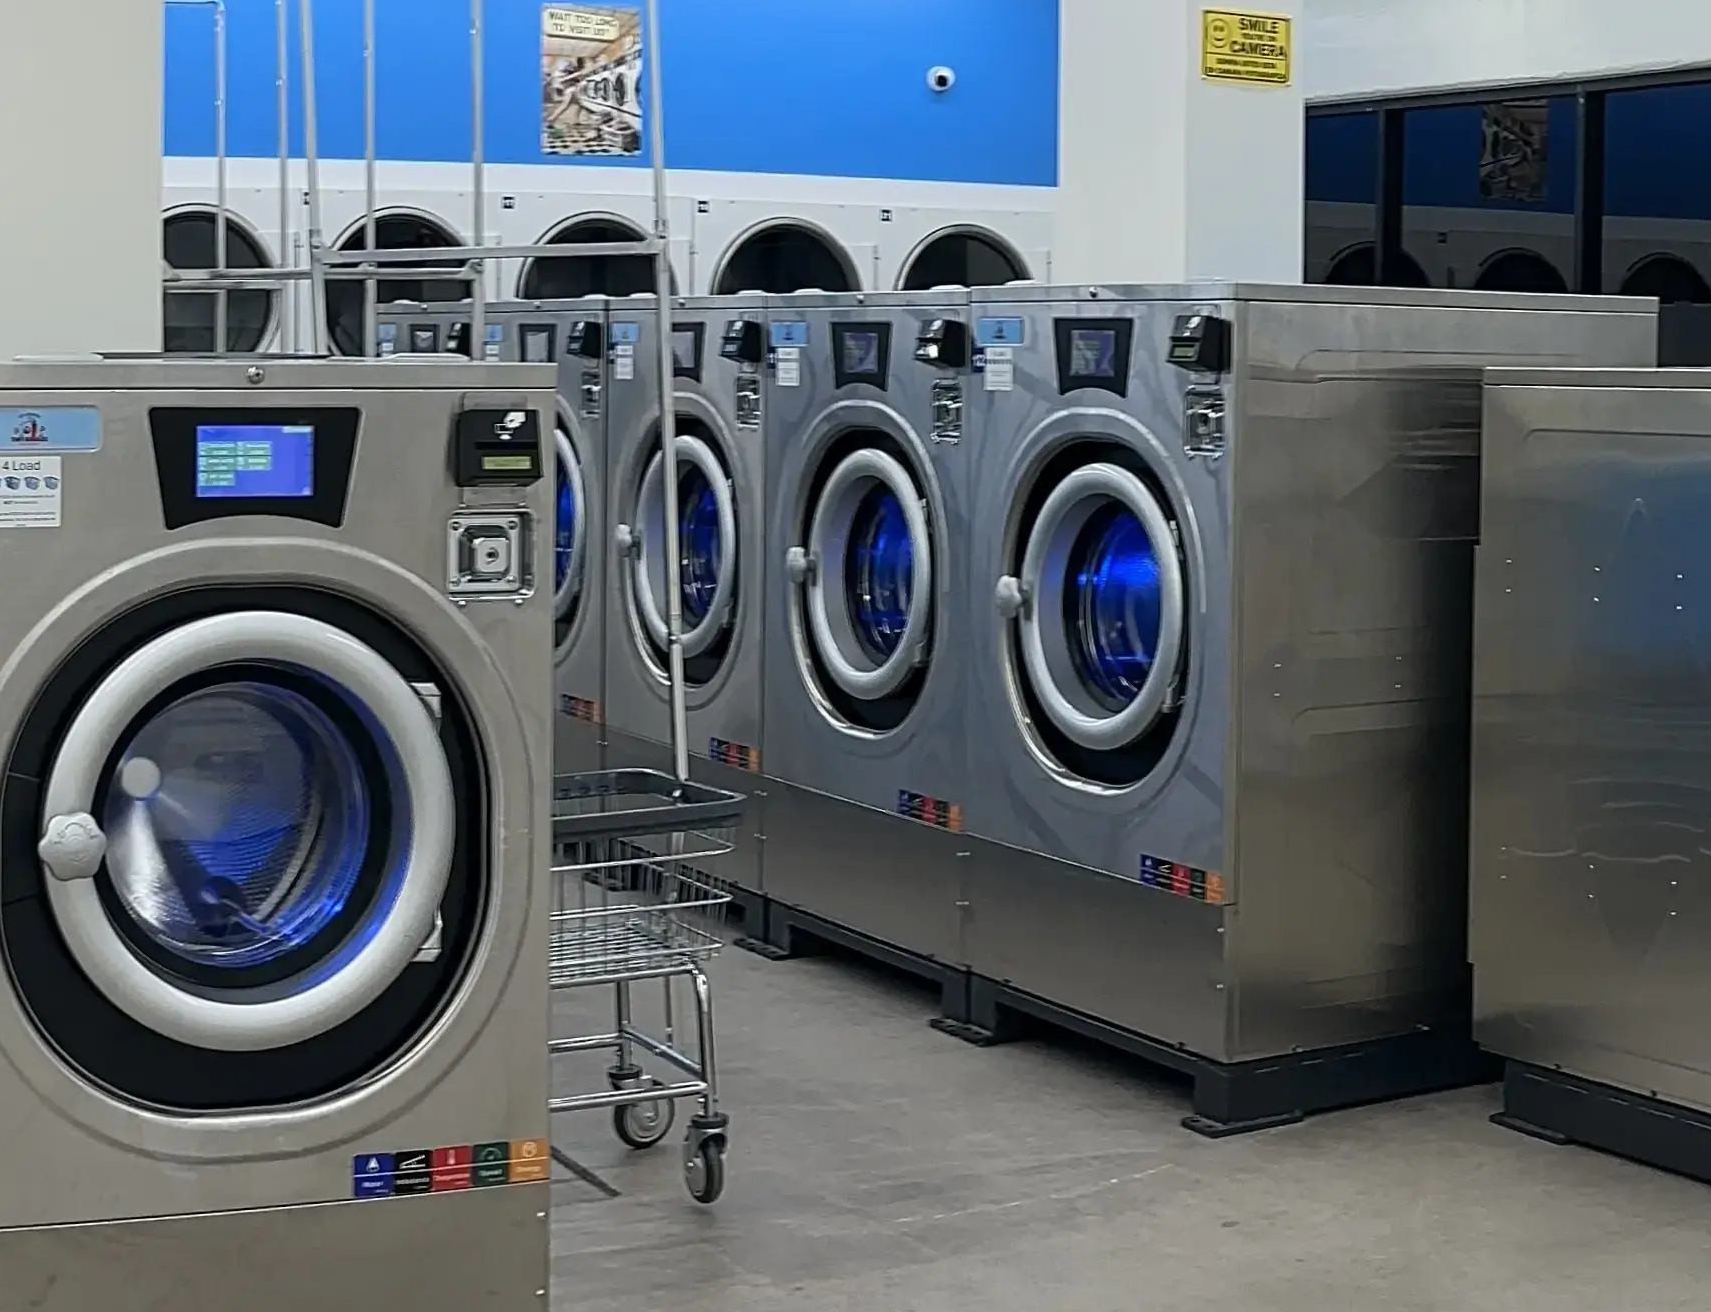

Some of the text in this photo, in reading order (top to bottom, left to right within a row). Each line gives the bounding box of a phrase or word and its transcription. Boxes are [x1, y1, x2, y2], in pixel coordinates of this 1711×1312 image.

[1238, 18, 1279, 34] SMILE
[1229, 40, 1287, 58] CAMERA
[1, 460, 41, 471] 4 Load
